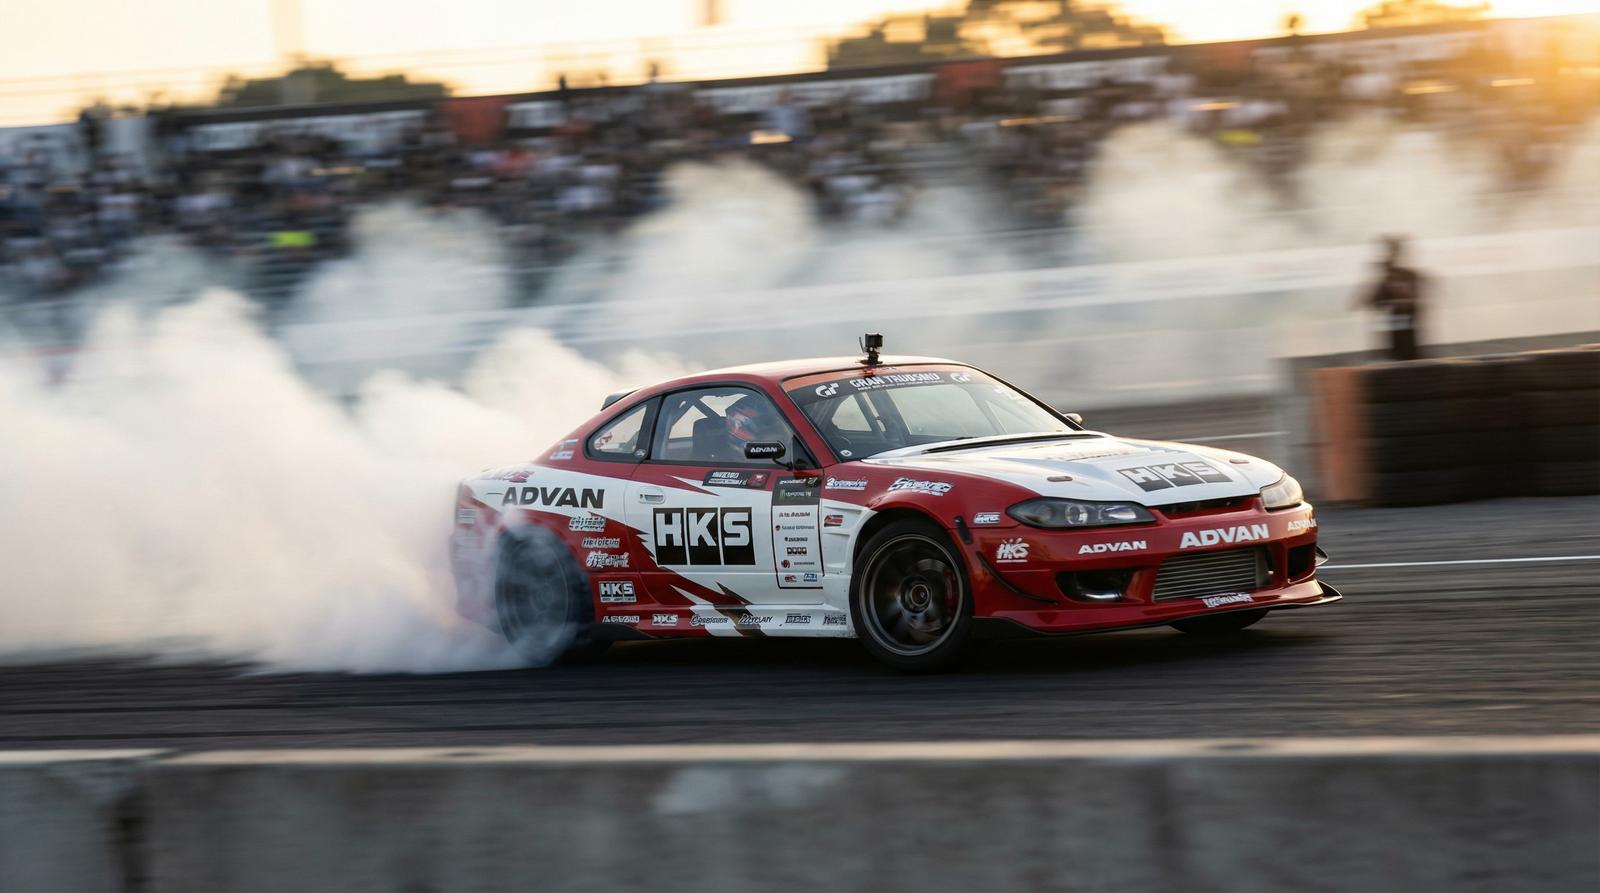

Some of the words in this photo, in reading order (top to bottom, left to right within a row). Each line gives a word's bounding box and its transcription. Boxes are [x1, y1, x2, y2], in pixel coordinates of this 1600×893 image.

[849, 376, 886, 388] GRAN
[1117, 460, 1225, 485] HKS
[502, 486, 605, 509] ADVAN
[655, 511, 751, 547] HKS
[1179, 523, 1270, 549] ADVAN
[996, 537, 1030, 560] HKS
[1078, 540, 1147, 554] ADVAN
[600, 583, 634, 595] HKS
[653, 615, 678, 623] HKS
